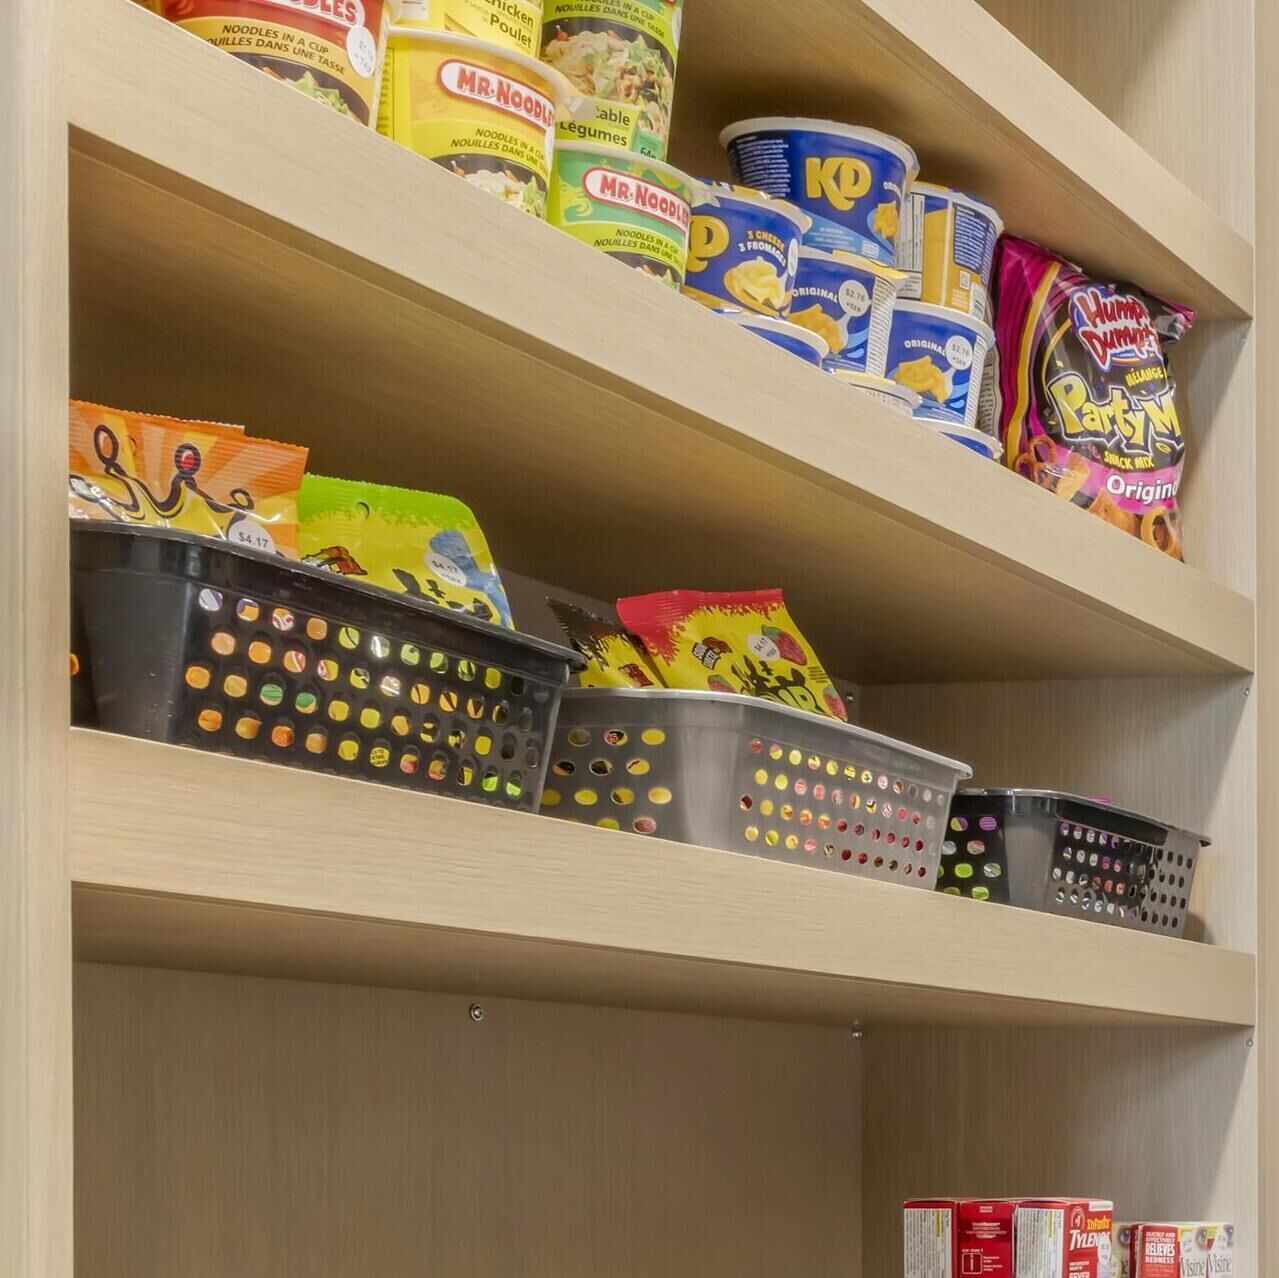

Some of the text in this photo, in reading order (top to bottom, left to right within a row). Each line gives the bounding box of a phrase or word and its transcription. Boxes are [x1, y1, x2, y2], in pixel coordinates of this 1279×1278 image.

[555, 4, 601, 13] NOUILLES
[222, 24, 278, 38] NOODLES
[282, 33, 295, 43] IN
[309, 41, 329, 54] CUP
[489, 13, 532, 49] Poulet
[205, 37, 252, 47] OUILLES
[257, 38, 288, 52] DANS
[293, 47, 314, 60] UNE
[319, 55, 345, 75] TASSE
[476, 128, 518, 145] NOODLES
[451, 139, 498, 150] NOUILLES
[502, 144, 526, 158] DANS
[616, 229, 653, 244] NOODLES
[793, 287, 839, 303] ORIGINAL
[1104, 451, 1156, 469] SNACK MIX
[1146, 1243, 1176, 1256] RELIEVES
[1180, 1257, 1205, 1277] Visine
[1208, 1253, 1232, 1273] Visine
